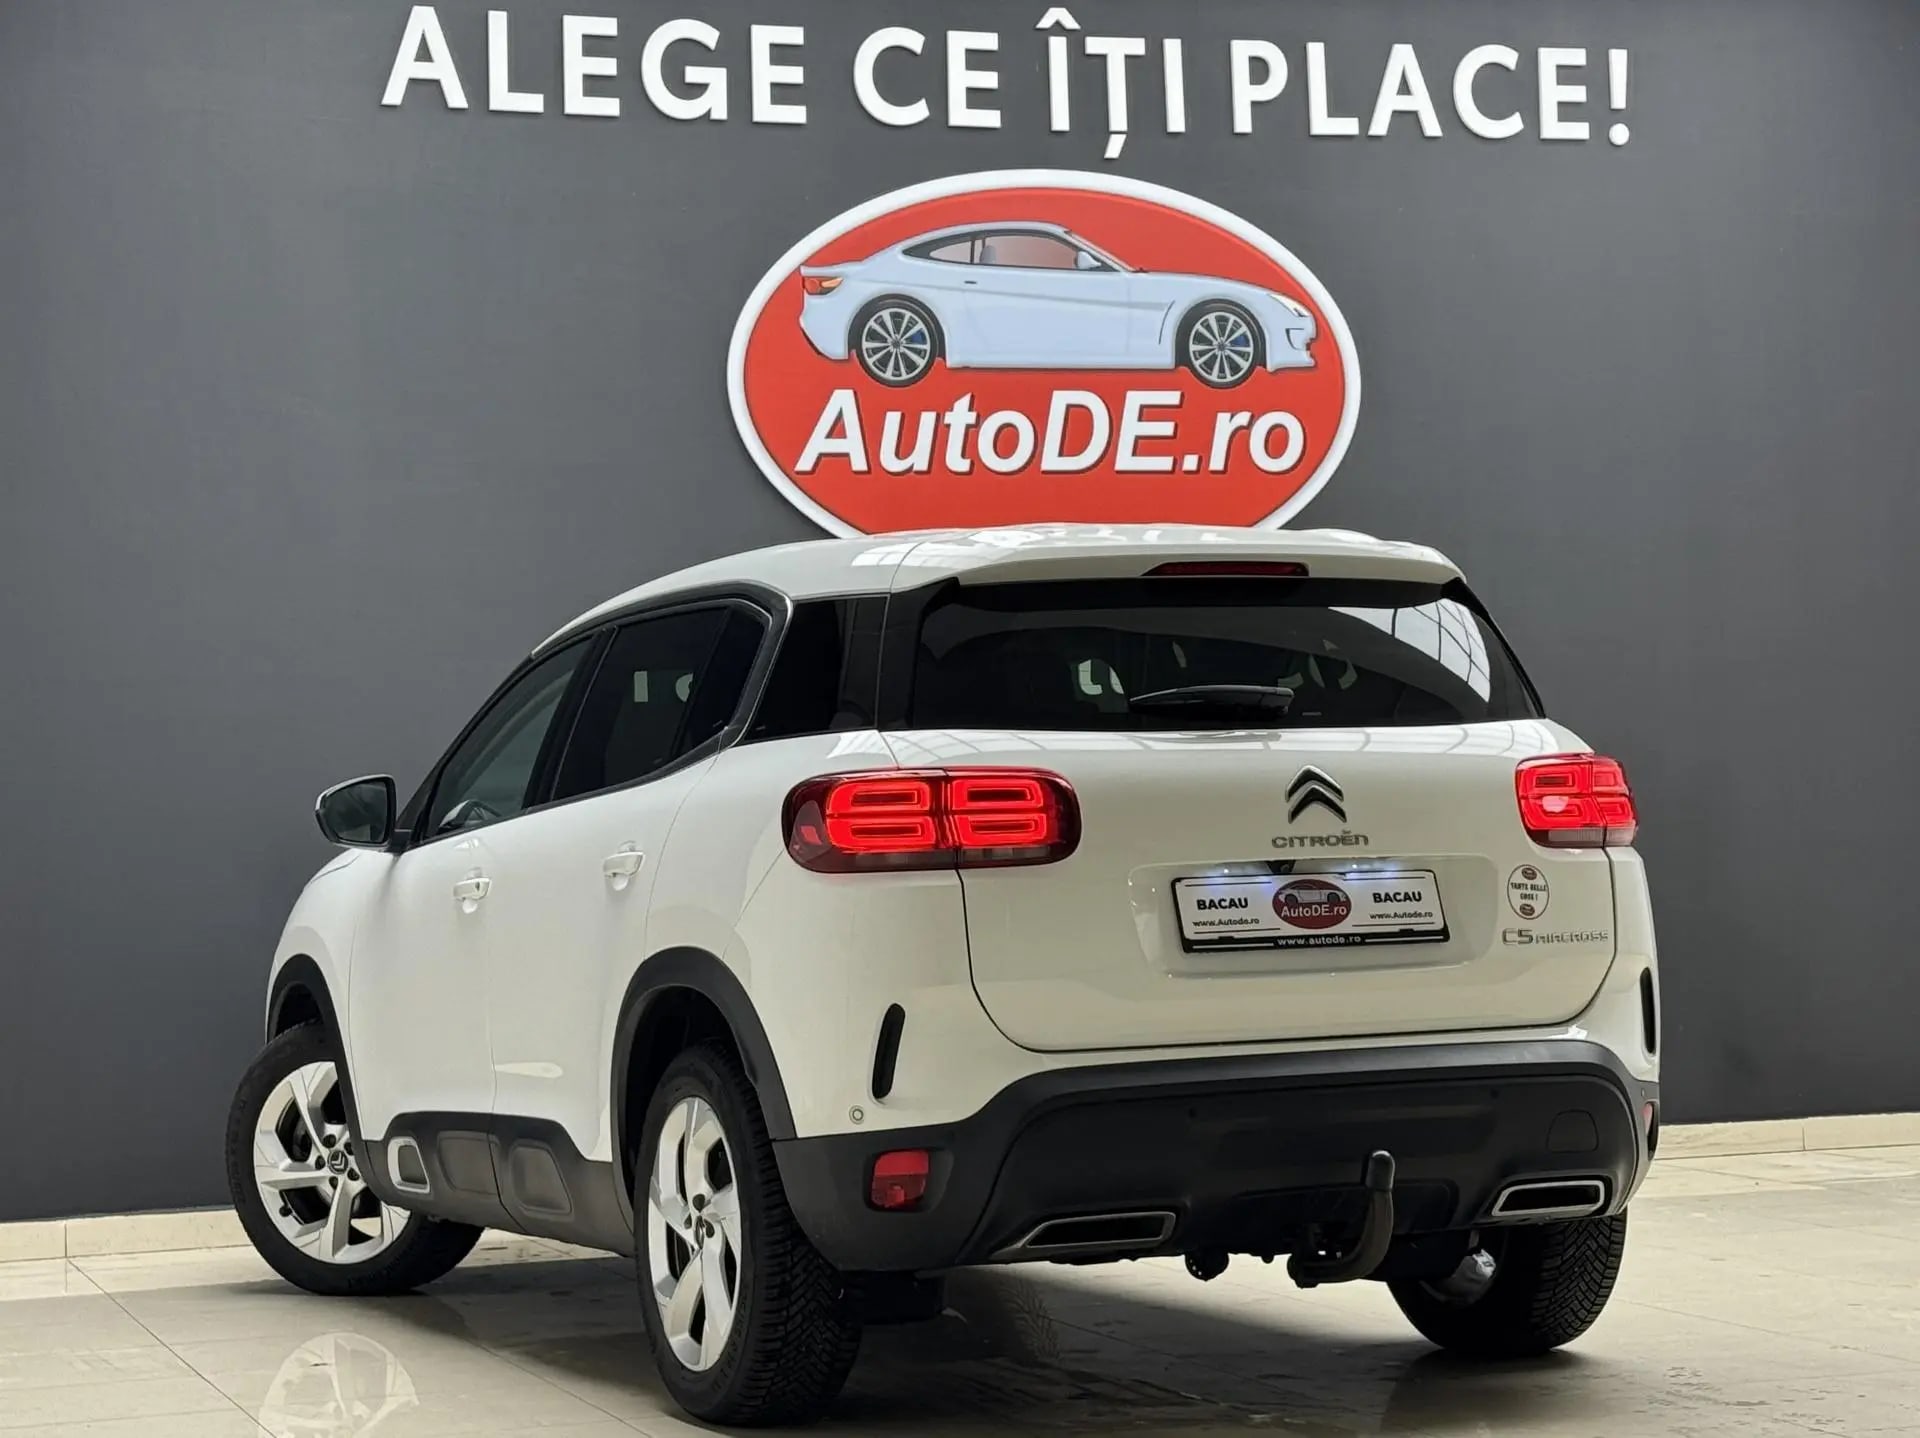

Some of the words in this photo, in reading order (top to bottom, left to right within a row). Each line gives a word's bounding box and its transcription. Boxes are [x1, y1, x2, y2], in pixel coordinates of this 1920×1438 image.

[381, 5, 807, 124] ALEGE
[853, 26, 1003, 129] CE
[1230, 39, 1631, 147] PLACE!
[794, 388, 1305, 474] AutoDE.ro
[1196, 897, 1249, 911] BACAU
[1372, 891, 1422, 904] BACAU
[1280, 903, 1348, 918] AutoDE.ro
[1276, 934, 1362, 946] www.autode.ro
[1502, 928, 1534, 945] C5
[1536, 930, 1609, 945] AIRCROSS
